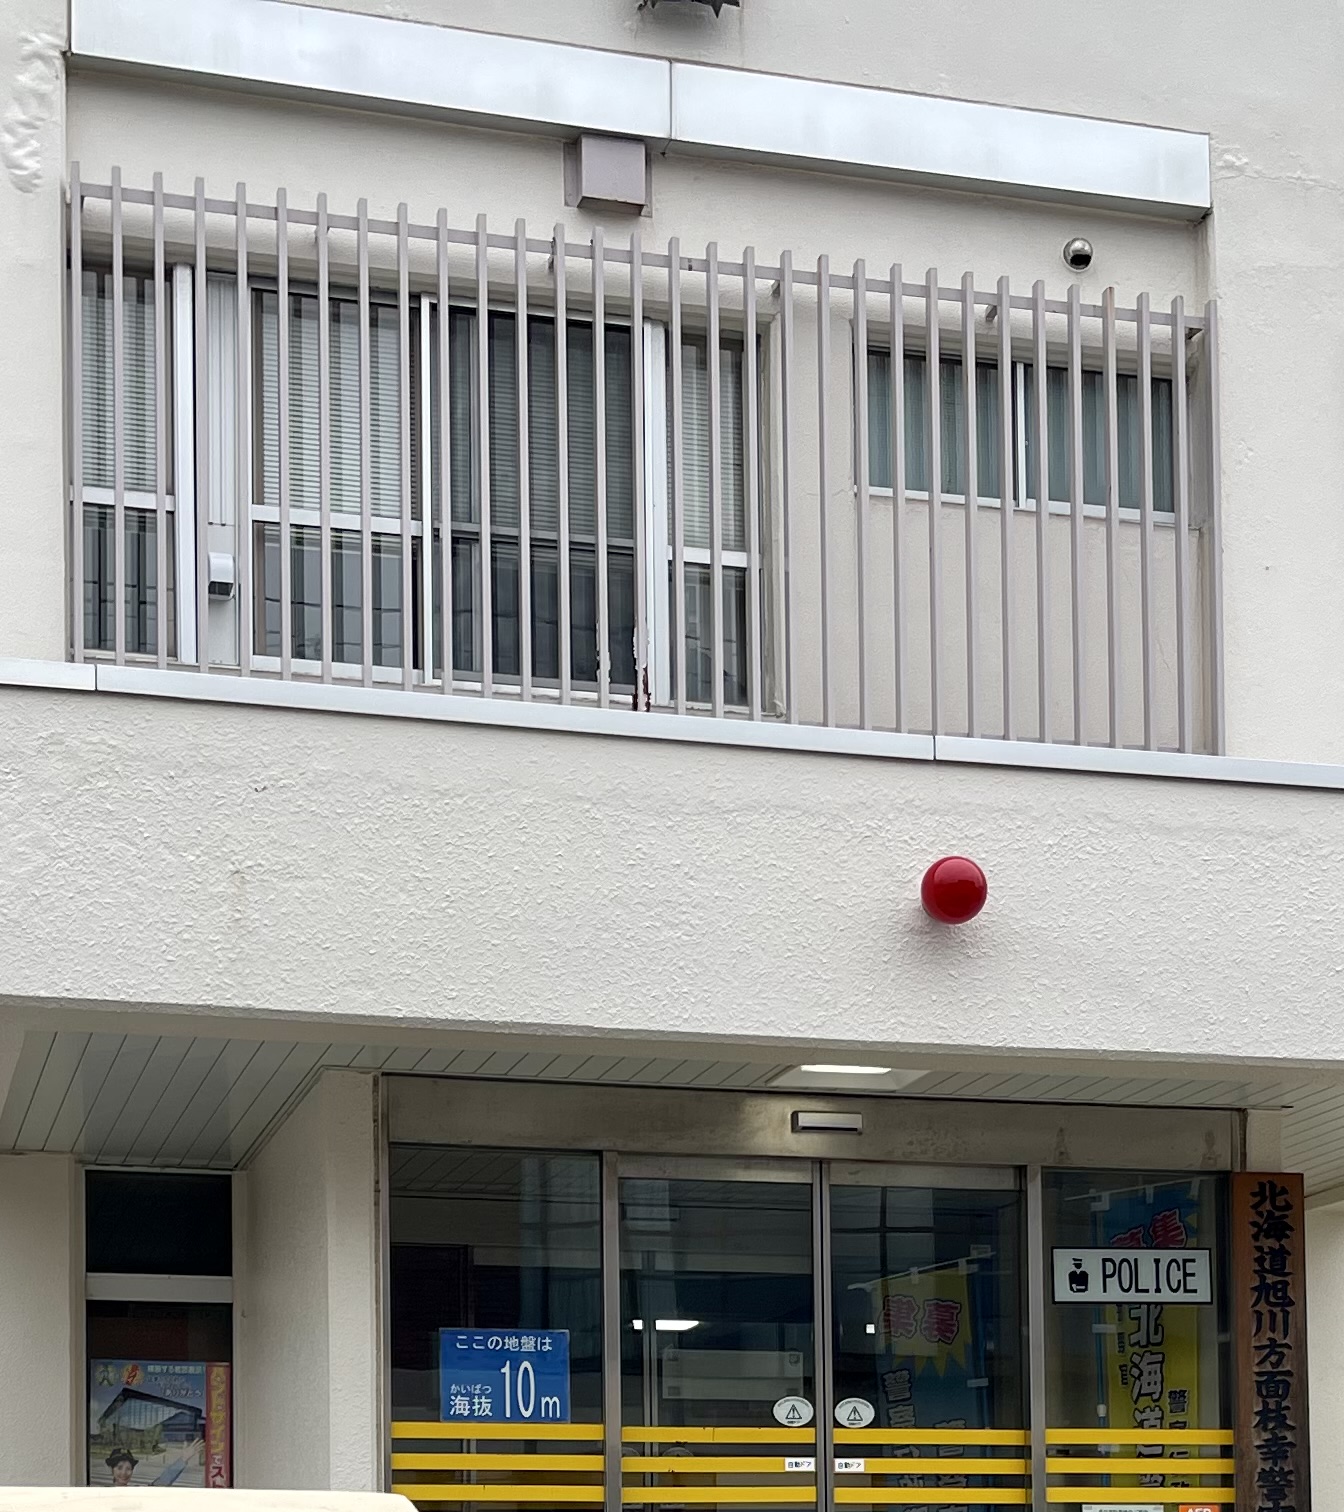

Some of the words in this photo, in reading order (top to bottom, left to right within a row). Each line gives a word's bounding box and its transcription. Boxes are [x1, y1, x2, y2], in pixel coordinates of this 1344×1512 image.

[1101, 1257, 1198, 1294] POLICE
[456, 1335, 553, 1352] ここの地盤は
[450, 1384, 492, 1394] かいばつ
[449, 1395, 493, 1417] 海抜
